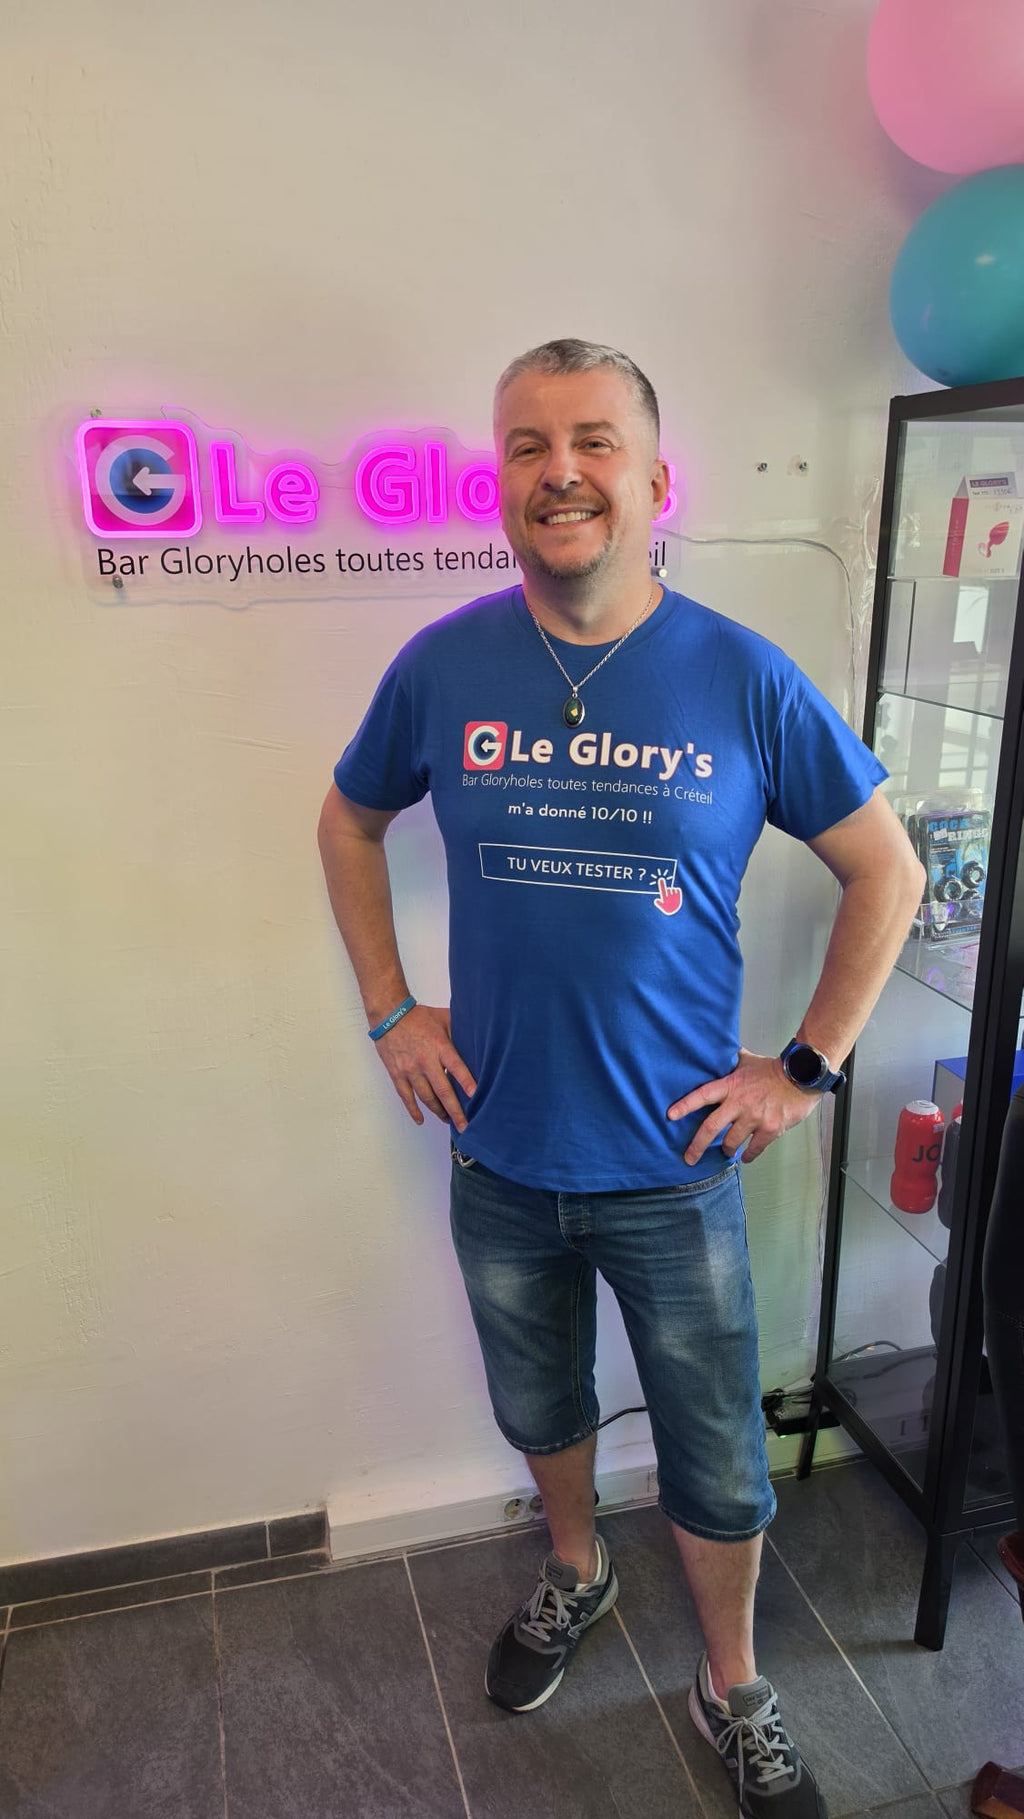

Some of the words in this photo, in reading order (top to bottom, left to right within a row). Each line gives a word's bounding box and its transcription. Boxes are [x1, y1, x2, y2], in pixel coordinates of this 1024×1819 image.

[210, 442, 319, 523] Le
[97, 548, 149, 576] Bar
[161, 546, 326, 581] Gloryholes
[335, 548, 425, 572] toutes
[510, 730, 553, 763] Le
[569, 732, 713, 781] Glory's
[462, 774, 478, 786] Bar
[481, 774, 543, 790] Gloryholes
[547, 778, 587, 791] toutes
[592, 780, 659, 796] tendances
[662, 784, 670, 797] à
[675, 786, 713, 804] Créteil
[508, 802, 534, 816] m'a
[539, 804, 587, 819] donné
[592, 807, 638, 823] 10/10
[642, 811, 653, 824] !!
[507, 857, 527, 870] TU
[531, 860, 572, 875] VEUX
[576, 863, 633, 880] TESTER
[638, 868, 647, 880] ?
[382, 1022, 391, 1030] Le
